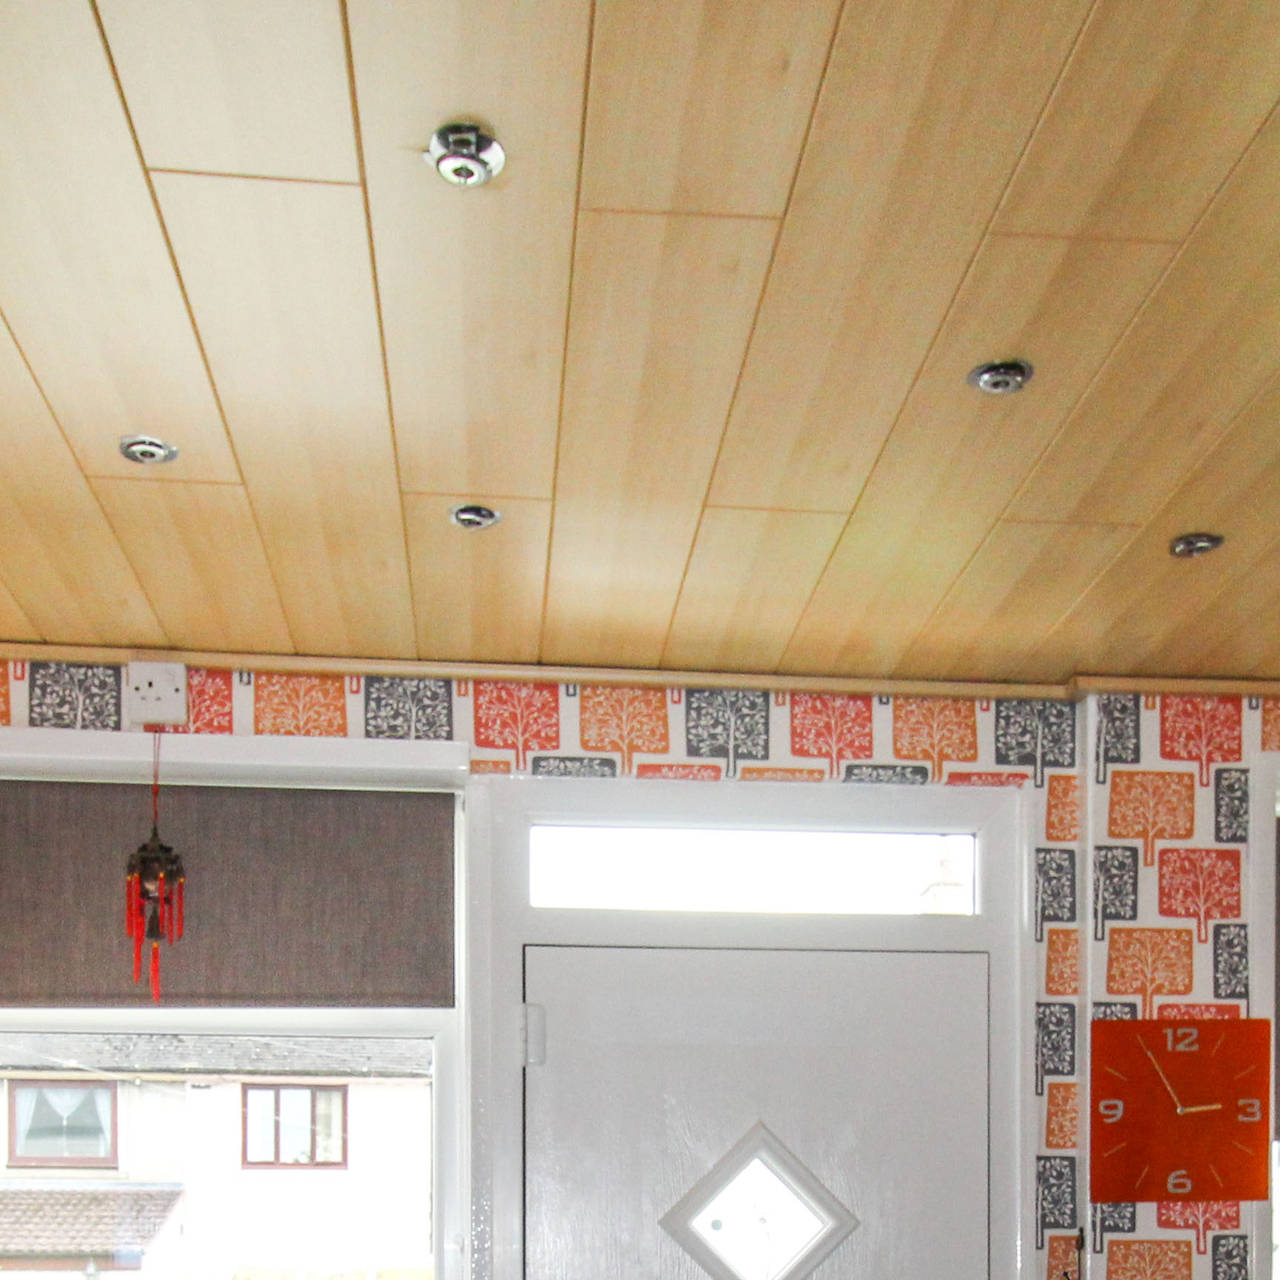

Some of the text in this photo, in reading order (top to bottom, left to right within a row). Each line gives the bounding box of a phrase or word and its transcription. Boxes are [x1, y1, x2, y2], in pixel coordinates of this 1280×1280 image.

[1163, 1028, 1199, 1052] 12
[1099, 1099, 1124, 1123] 9
[1237, 1099, 1262, 1122] 3
[1167, 1169, 1192, 1193] 6
